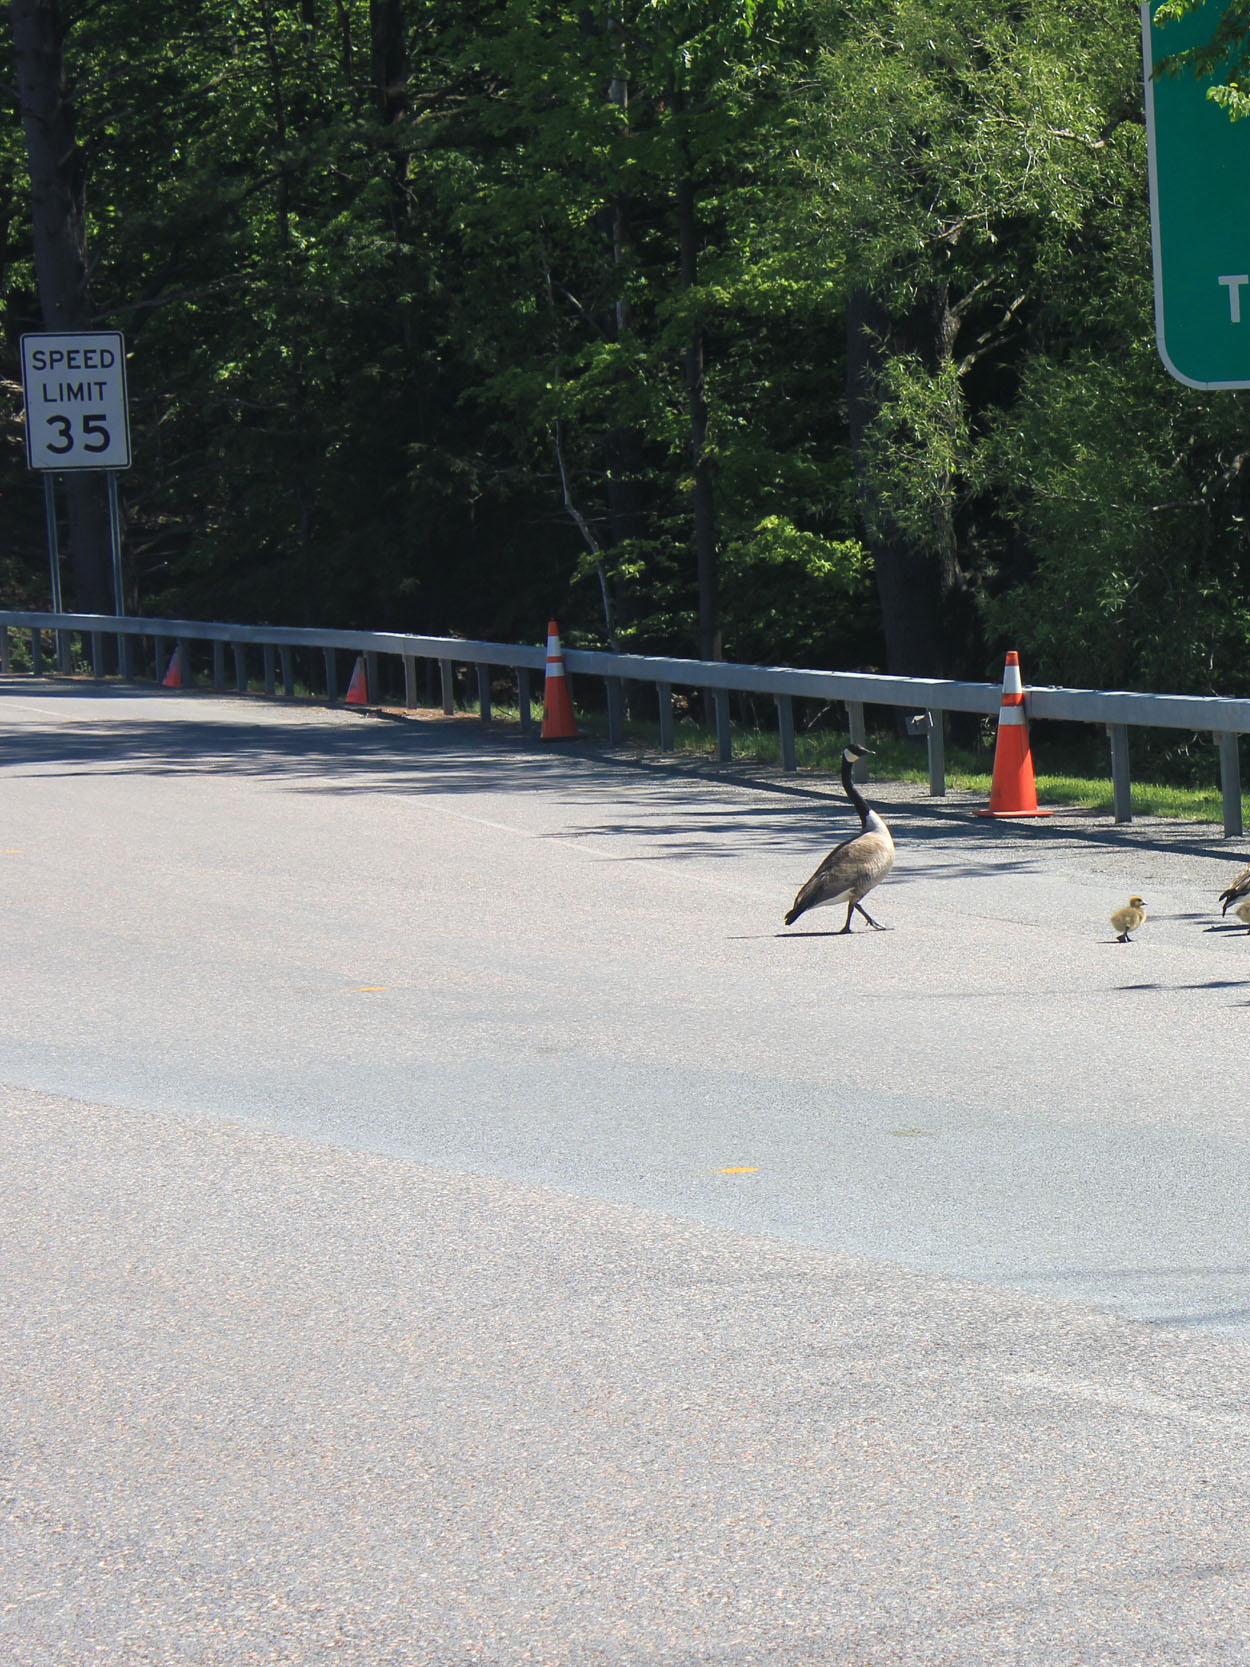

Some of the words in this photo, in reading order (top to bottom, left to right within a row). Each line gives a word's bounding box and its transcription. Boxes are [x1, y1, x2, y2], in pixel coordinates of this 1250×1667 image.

[32, 349, 115, 371] SPEED
[42, 381, 107, 402] LIMIT
[46, 414, 111, 454] 35
